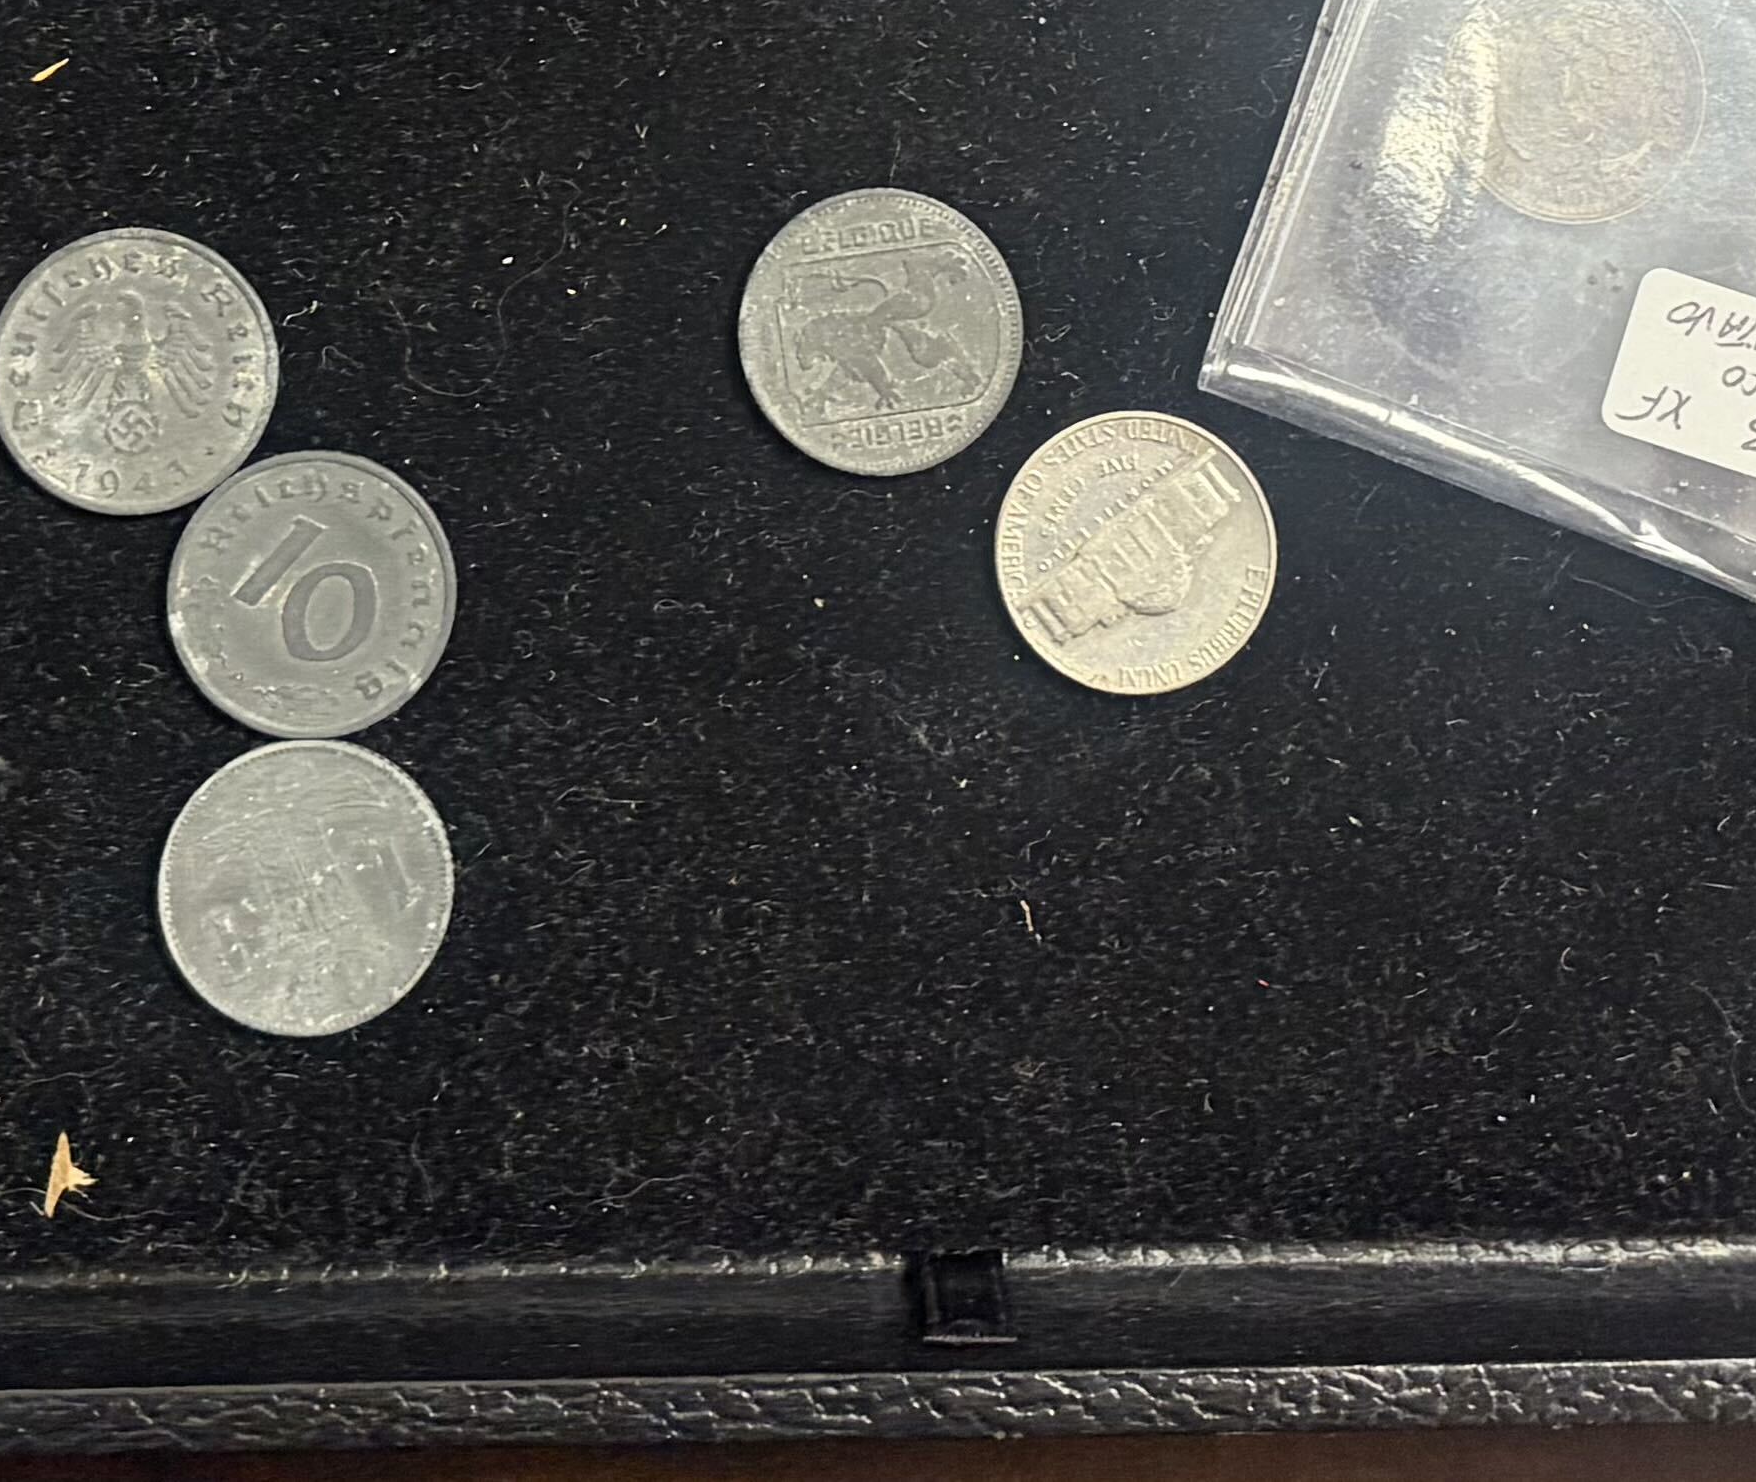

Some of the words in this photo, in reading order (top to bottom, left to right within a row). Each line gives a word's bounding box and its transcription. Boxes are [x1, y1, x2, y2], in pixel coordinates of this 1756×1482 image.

[799, 217, 936, 256] BELGIQUE
[1614, 386, 1692, 431] XF
[229, 513, 380, 663] 10
